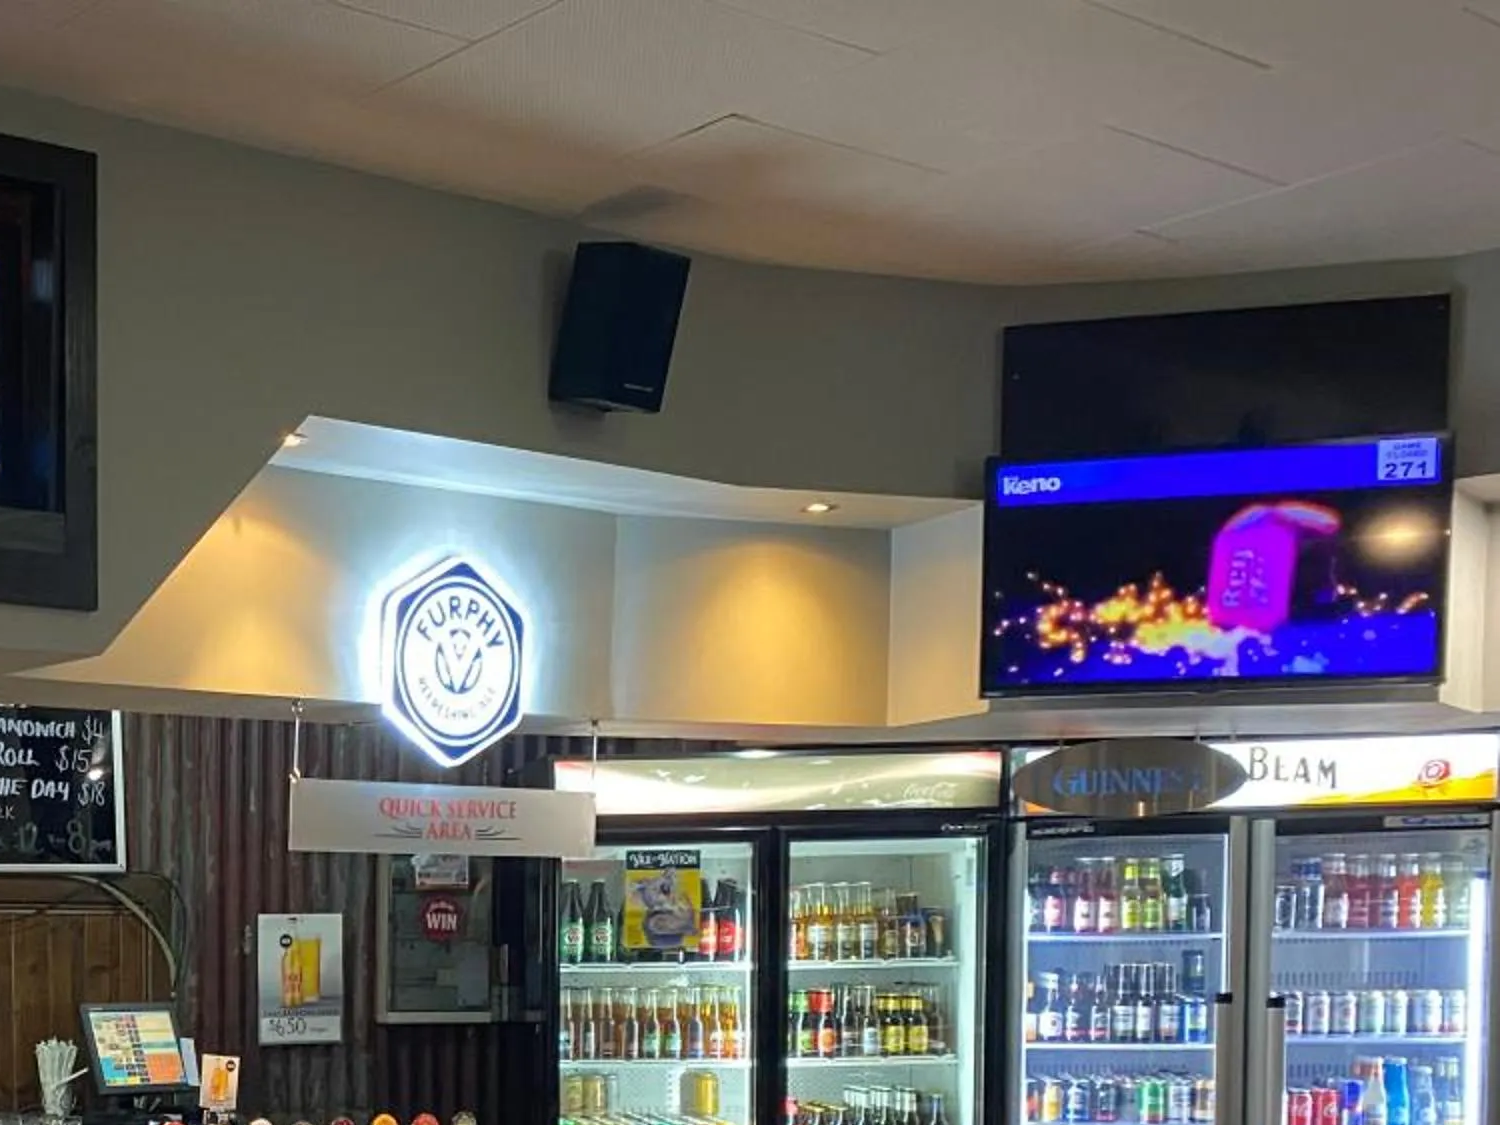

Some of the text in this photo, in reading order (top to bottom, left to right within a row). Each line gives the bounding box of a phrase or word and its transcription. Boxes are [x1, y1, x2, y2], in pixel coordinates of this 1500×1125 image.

[1383, 460, 1427, 479] 271
[416, 594, 505, 650] FURPHY
[55, 745, 93, 773] $15
[1250, 746, 1337, 790] BEAM
[31, 778, 70, 800] DAY
[1053, 766, 1206, 797] GUINNES
[379, 796, 518, 820] QUICK SERVICE
[425, 822, 474, 841] AREA
[425, 912, 458, 933] WIN
